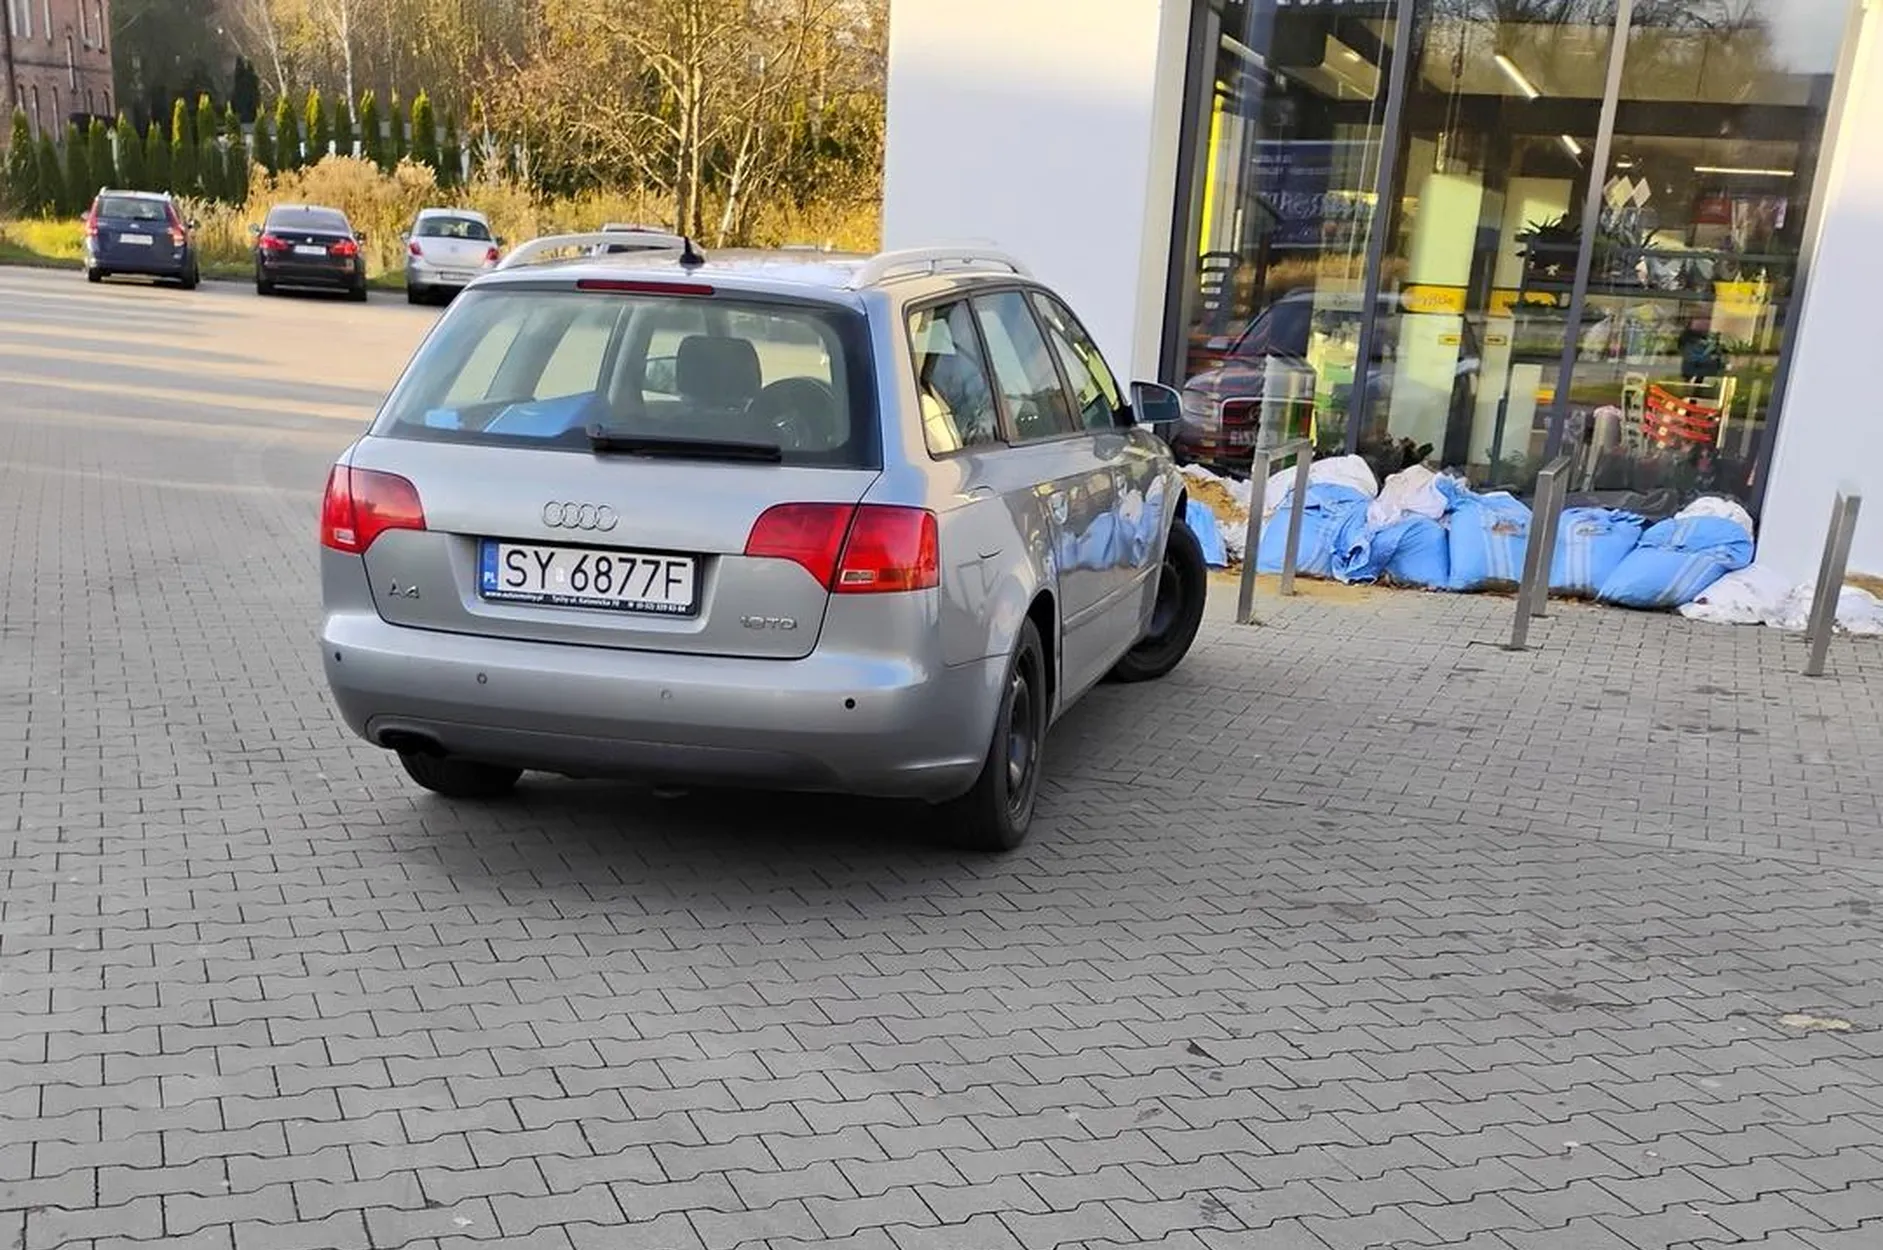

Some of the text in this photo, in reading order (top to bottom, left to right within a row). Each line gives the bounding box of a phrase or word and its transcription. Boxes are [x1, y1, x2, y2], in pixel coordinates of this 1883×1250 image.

[483, 571, 496, 583] PL
[505, 549, 688, 599] SY 6877F
